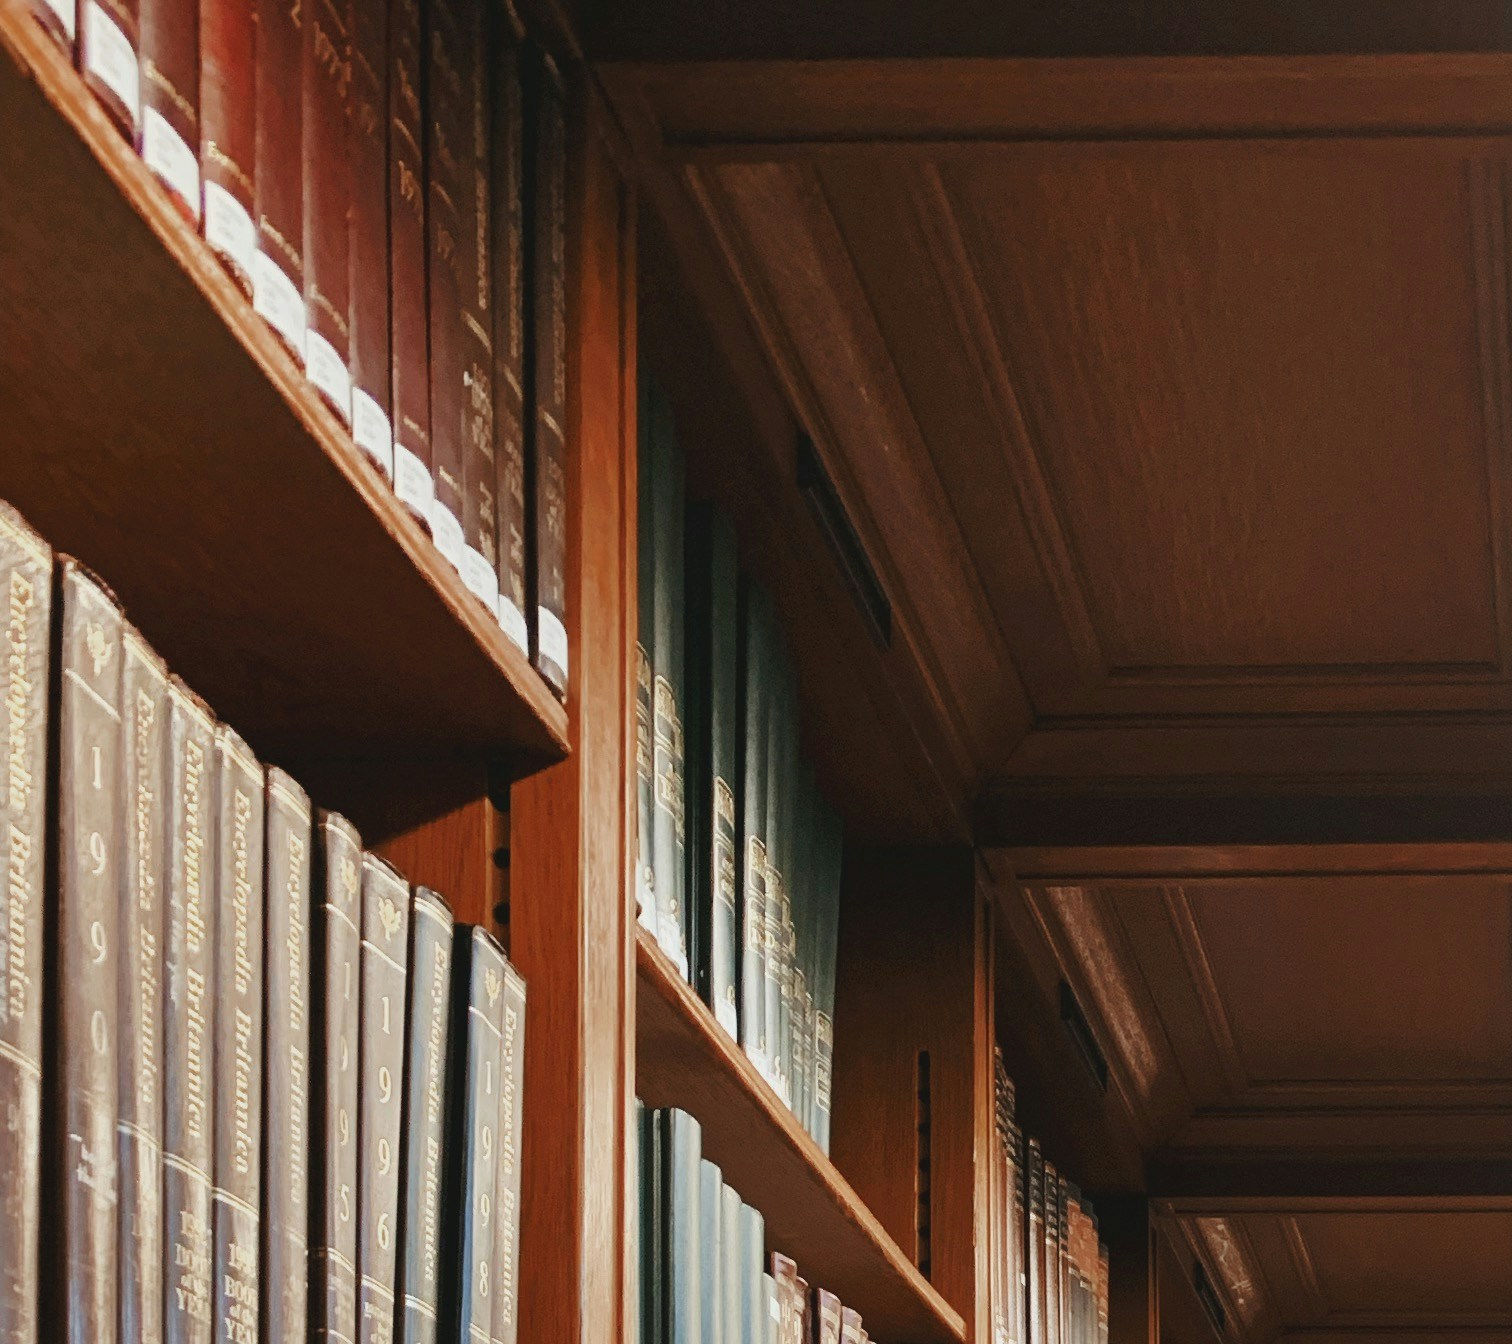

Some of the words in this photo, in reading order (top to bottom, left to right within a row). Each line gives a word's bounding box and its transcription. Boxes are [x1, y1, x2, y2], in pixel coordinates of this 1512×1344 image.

[8, 824, 32, 1018] Britannica
[377, 996, 392, 1250] 1996
[477, 1061, 493, 1298] 1998
